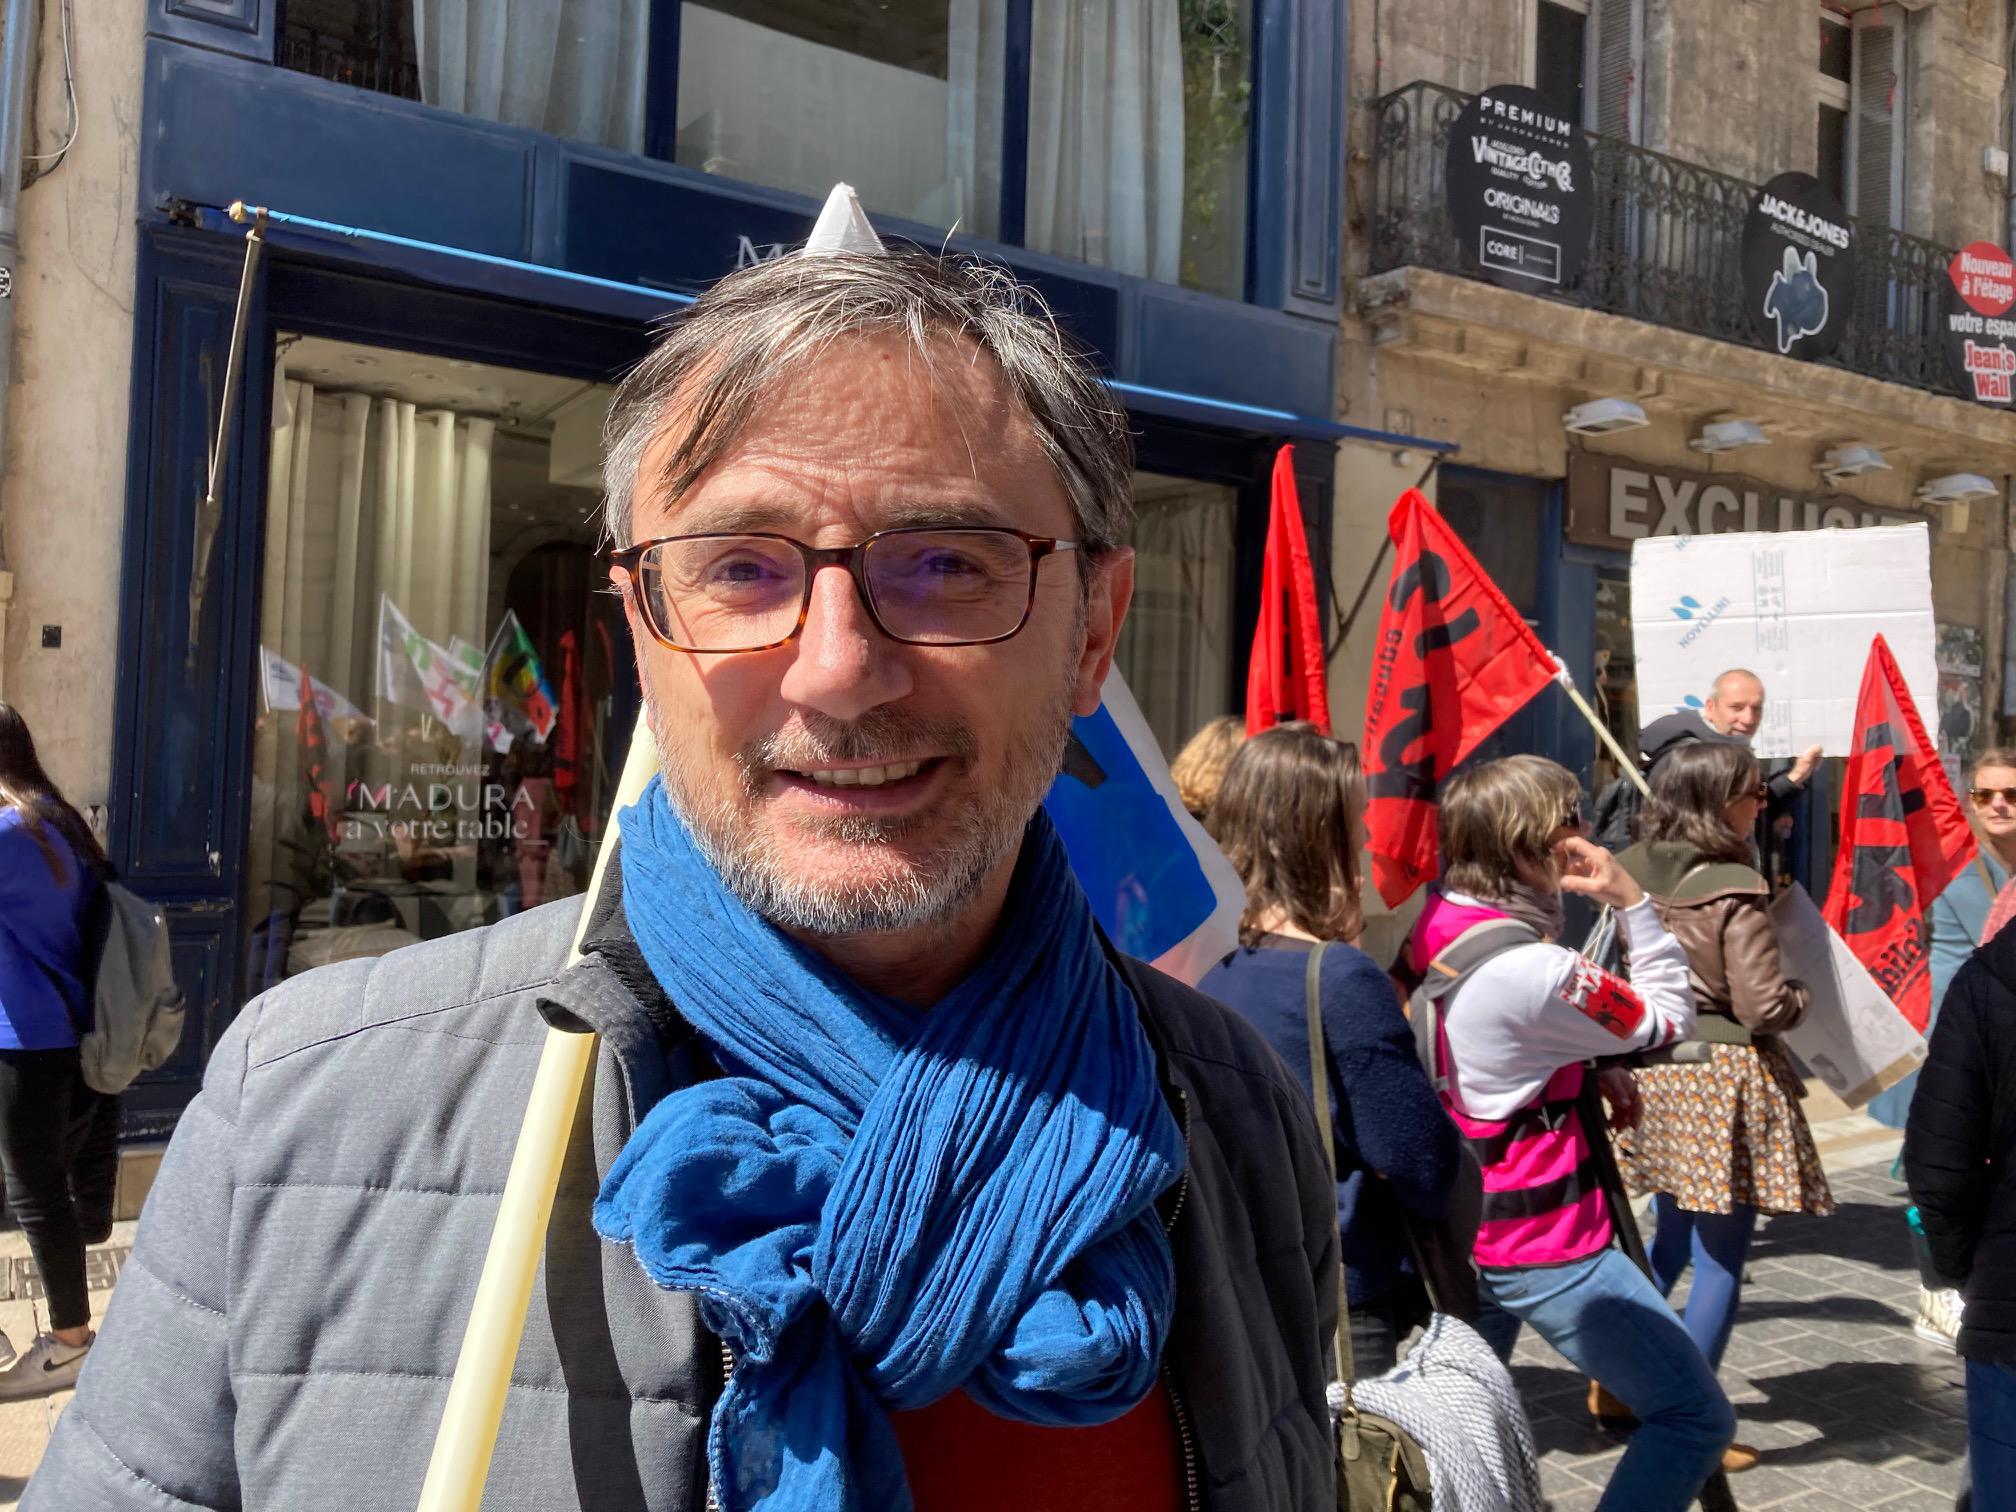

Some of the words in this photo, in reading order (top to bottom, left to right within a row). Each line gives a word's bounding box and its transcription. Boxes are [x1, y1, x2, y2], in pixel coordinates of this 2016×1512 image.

[1480, 96, 1571, 136] PREMIUM
[1483, 187, 1560, 225] ORIGINALS
[1486, 240, 1519, 260] CORE
[1960, 252, 2013, 279] Nouveau
[1961, 275, 1970, 296] à
[1974, 276, 2014, 304] l'étage
[1949, 312, 1983, 334] votre
[1985, 317, 2016, 340] espa
[1975, 373, 2010, 400] Wall
[410, 763, 490, 777] RETROUVEZ
[359, 782, 535, 812] MADURA
[373, 817, 450, 840] votre
[457, 811, 529, 840] table
